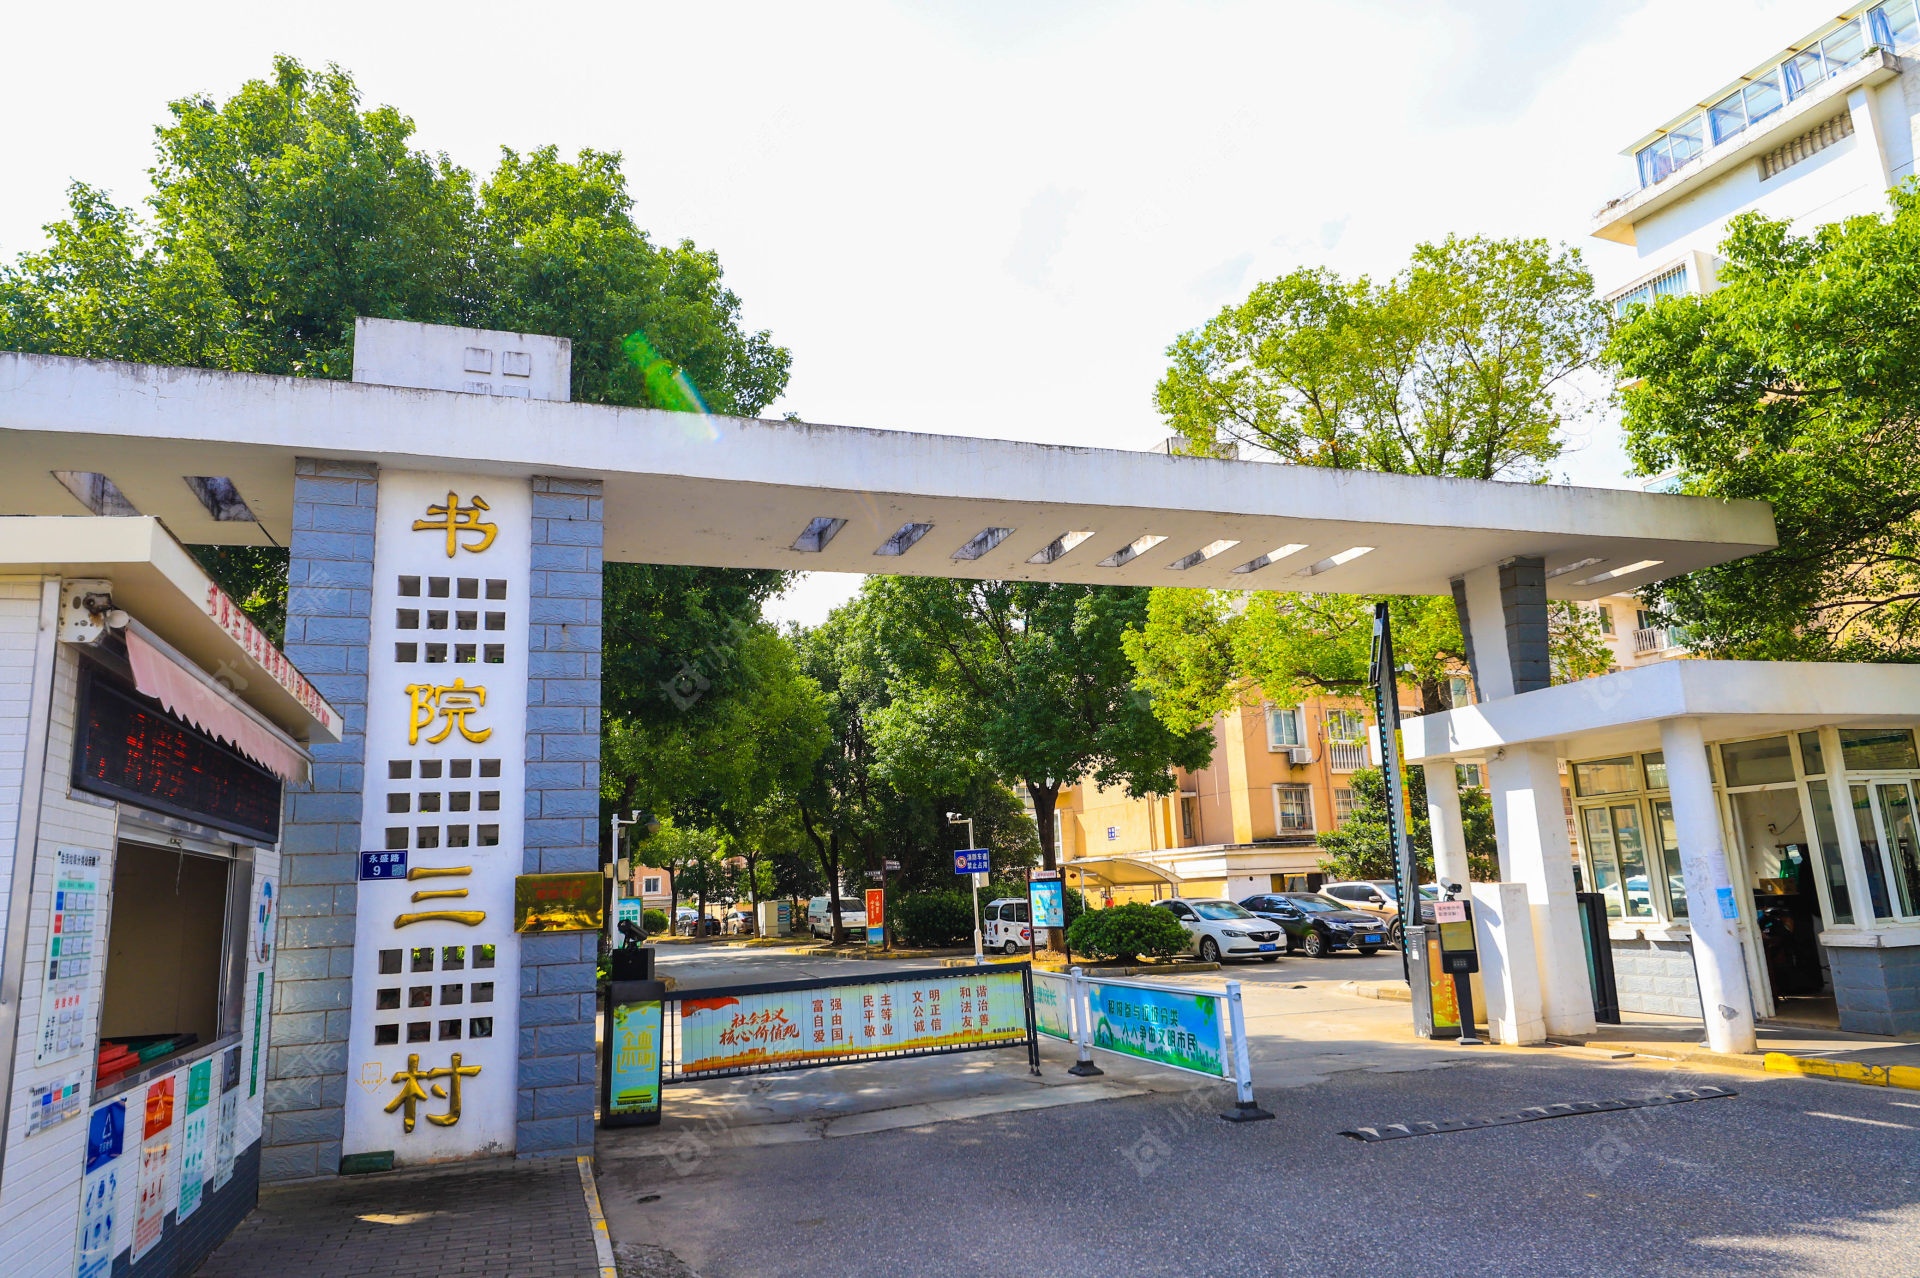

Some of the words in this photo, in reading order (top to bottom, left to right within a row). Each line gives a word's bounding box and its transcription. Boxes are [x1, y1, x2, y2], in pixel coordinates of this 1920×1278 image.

[384, 490, 498, 1133] 书院三村
[369, 853, 400, 864] 永盛路
[372, 865, 381, 876] 9
[812, 998, 842, 1012] 富强
[863, 993, 892, 1008] 民主
[912, 989, 941, 1003] 文明
[960, 984, 988, 999] 和谐
[731, 1007, 790, 1029] 社会主义
[813, 1013, 842, 1028] 自由
[863, 1008, 892, 1023] 平等
[912, 1004, 941, 1018] 公正
[960, 1000, 988, 1013] 法治
[719, 1022, 801, 1046] 核心价值观
[813, 1027, 843, 1043] 爱国
[863, 1022, 893, 1038] 敬业
[913, 1018, 942, 1033] 诚信
[961, 1013, 990, 1028] 友善
